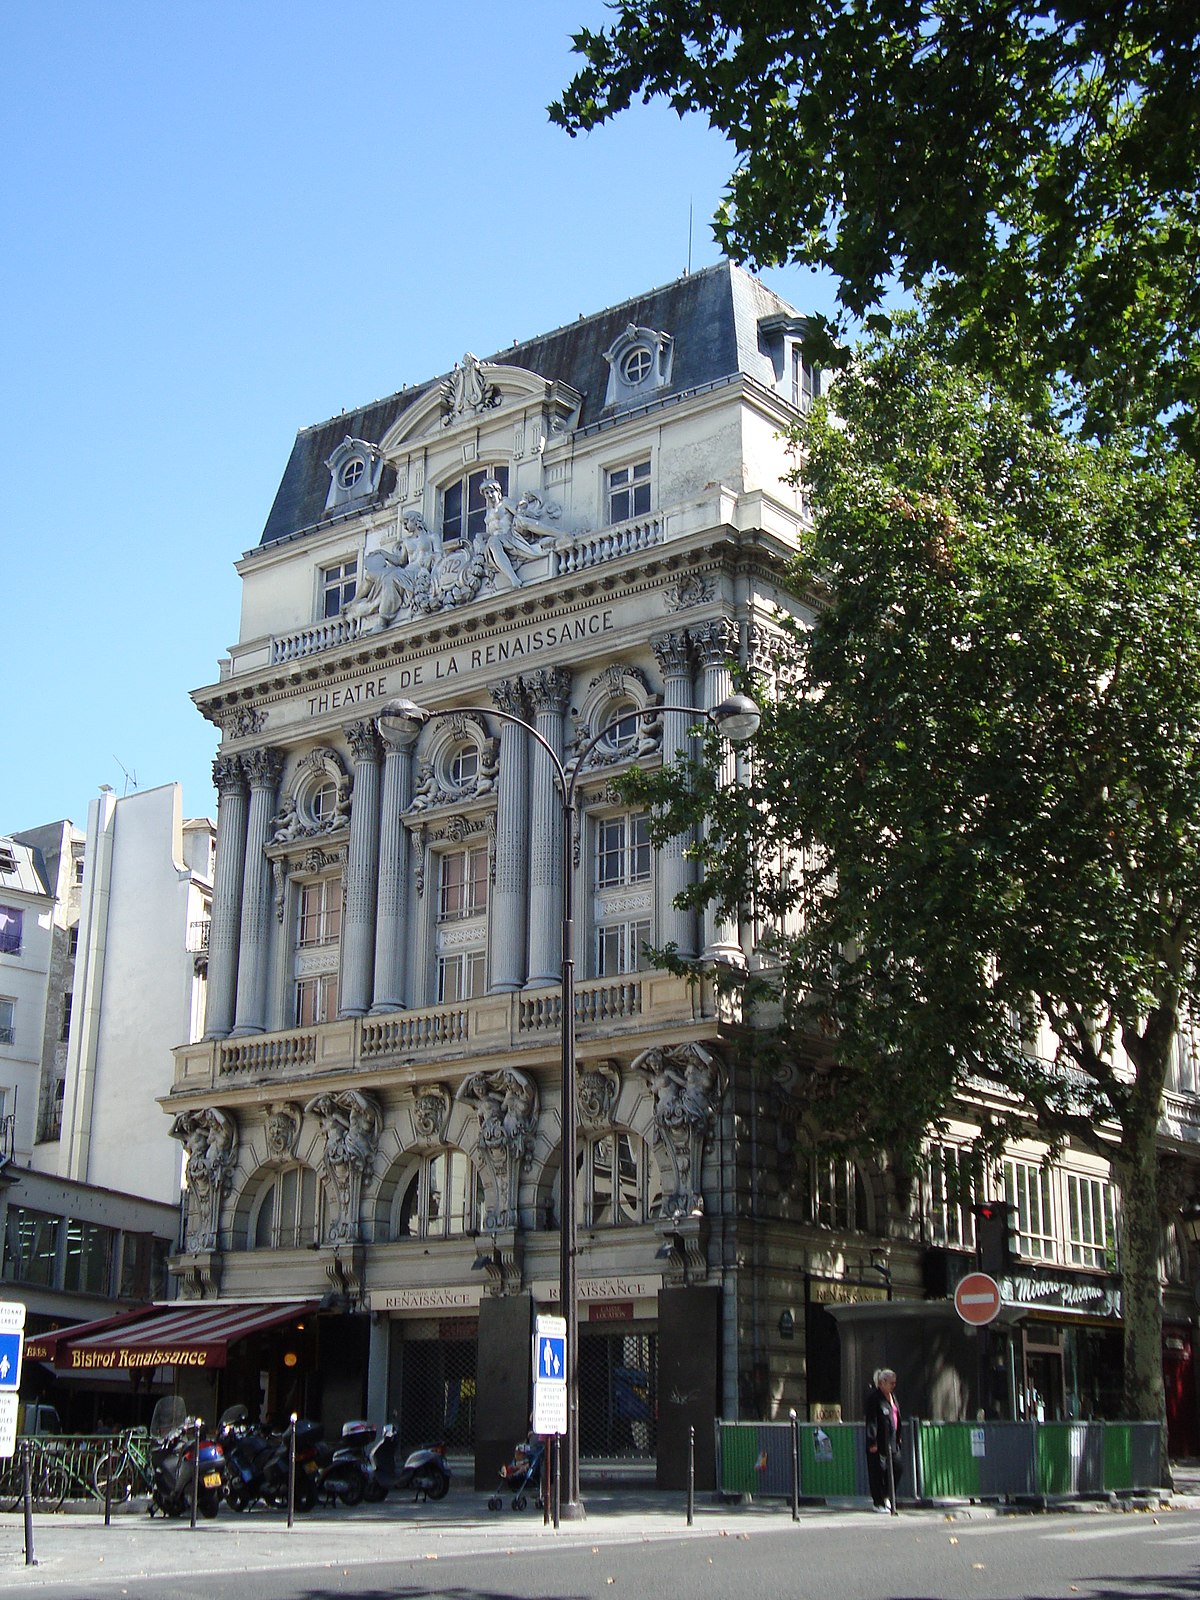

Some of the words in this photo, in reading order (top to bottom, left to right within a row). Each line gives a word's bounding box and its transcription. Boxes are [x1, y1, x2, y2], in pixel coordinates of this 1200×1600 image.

[308, 677, 387, 715] THEATRE
[401, 667, 423, 689] DE
[436, 656, 458, 679] LA
[471, 610, 614, 668] RENAISSANCE
[549, 1284, 646, 1298] RAISSANCE
[385, 1294, 470, 1307] RENAISSANCE
[71, 1350, 116, 1367] Bistrot
[118, 1349, 207, 1367] Renaissance
